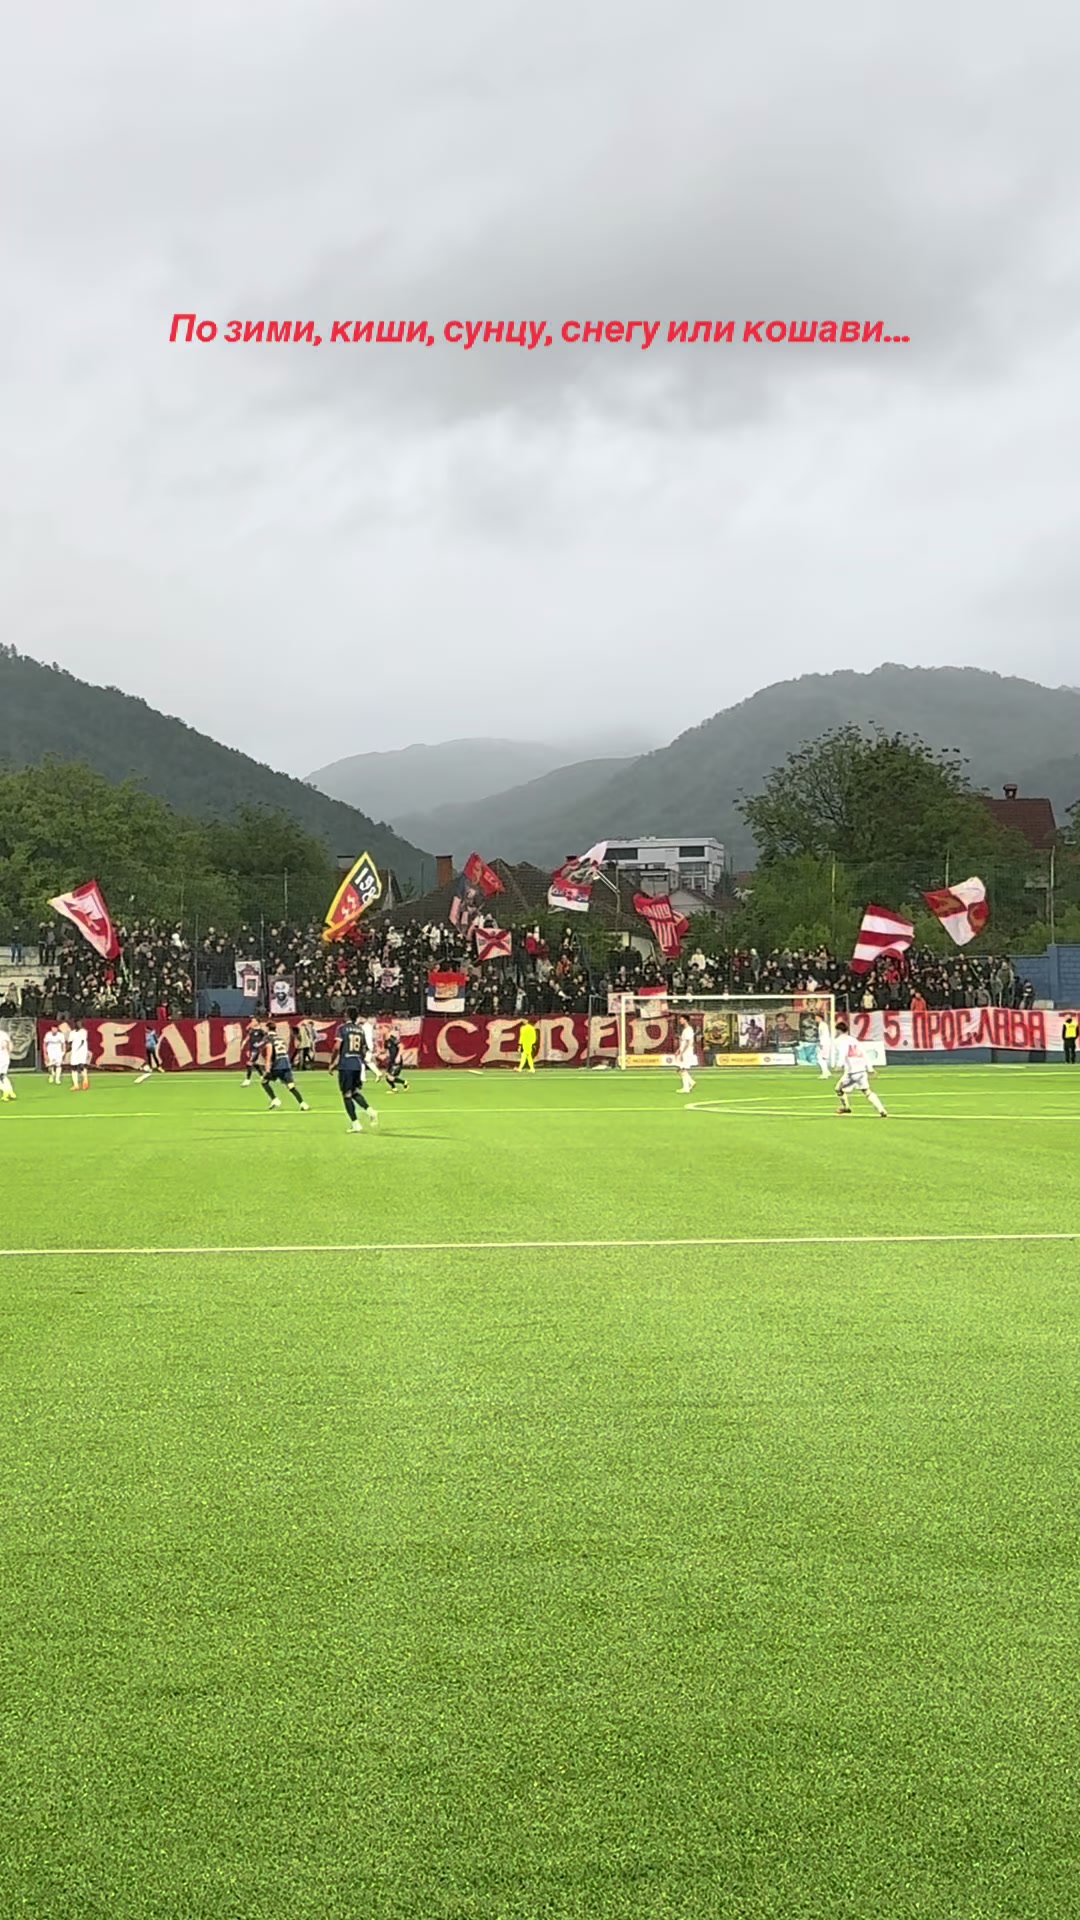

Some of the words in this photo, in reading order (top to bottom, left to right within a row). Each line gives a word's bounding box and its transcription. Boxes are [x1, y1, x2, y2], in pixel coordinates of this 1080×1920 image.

[349, 1034, 360, 1051] 18
[436, 1016, 669, 1064] СЕВЕР
[913, 1008, 1047, 1051] ПРОСЛАВА
